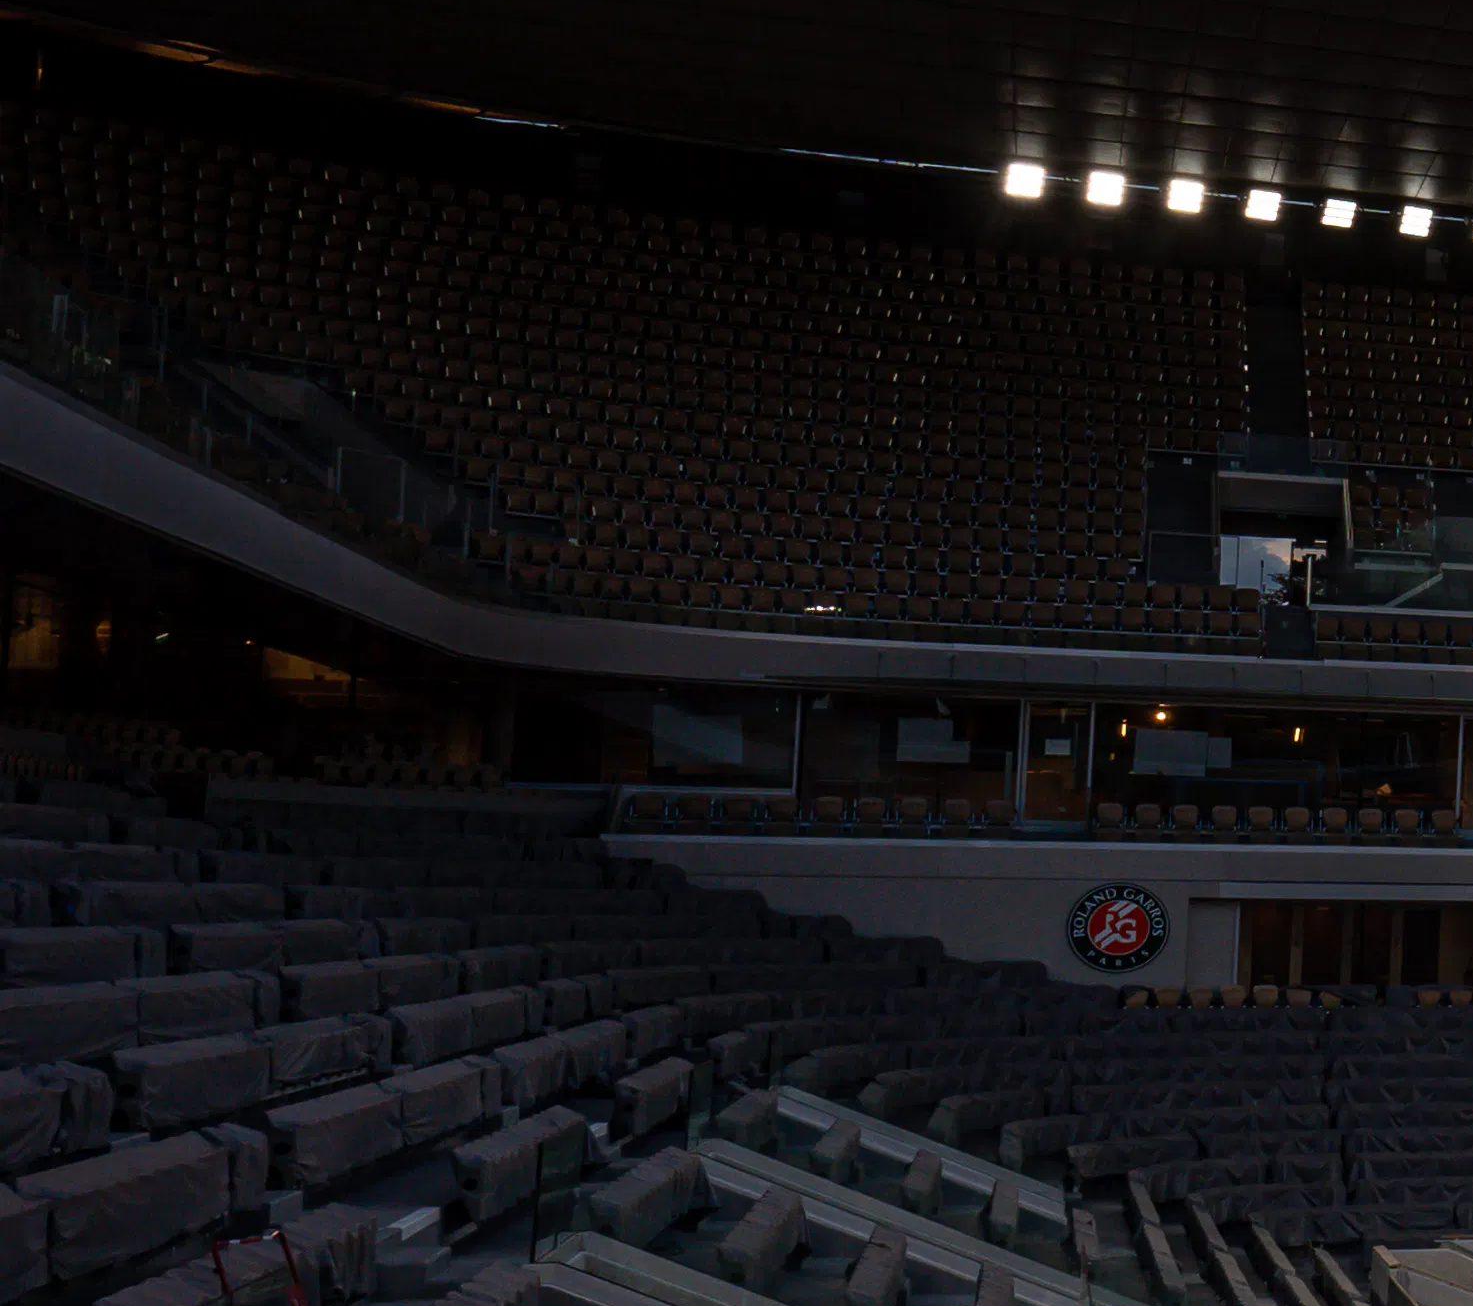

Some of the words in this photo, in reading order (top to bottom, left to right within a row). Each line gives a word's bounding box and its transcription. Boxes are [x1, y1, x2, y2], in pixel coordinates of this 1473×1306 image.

[1073, 887, 1117, 938] ROLAND
[1123, 887, 1165, 938] GARROS
[1086, 949, 1150, 967] PARIS
